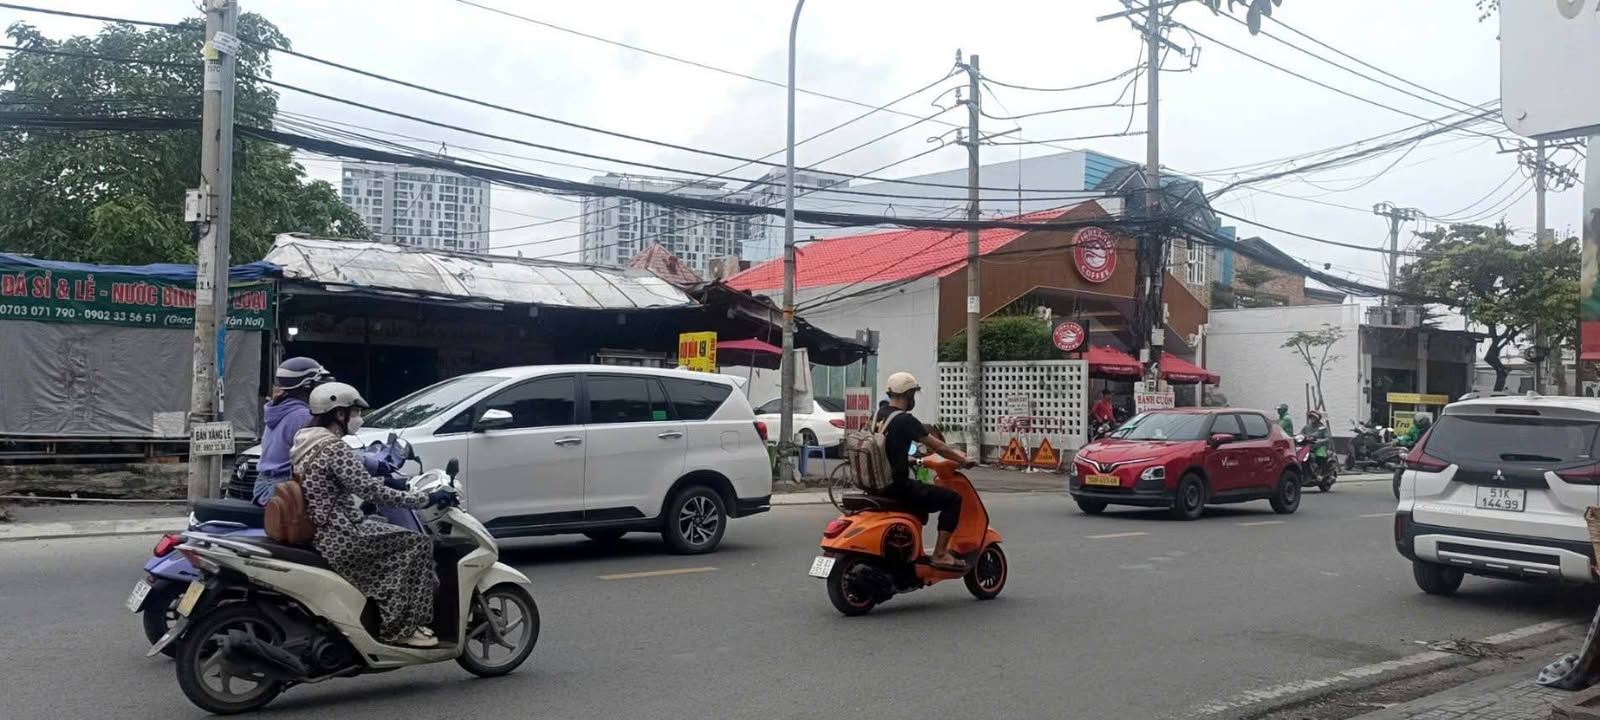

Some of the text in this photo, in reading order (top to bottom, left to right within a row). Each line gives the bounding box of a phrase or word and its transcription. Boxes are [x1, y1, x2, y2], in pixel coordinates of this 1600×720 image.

[2, 270, 28, 297] ĐÁ
[32, 269, 52, 299] SỈ
[56, 278, 70, 300] &
[75, 274, 95, 302] LẺ
[112, 281, 158, 306] NƯỚC
[0, 304, 28, 315] 0703
[31, 305, 51, 316] 071
[55, 308, 76, 318] 790
[84, 309, 110, 321] 0902
[113, 312, 126, 321] 33
[129, 313, 142, 322] 56
[145, 314, 156, 323] 51
[245, 317, 265, 328] Nơi)
[1490, 488, 1510, 498] 51K
[1482, 497, 1518, 509] 144.99
